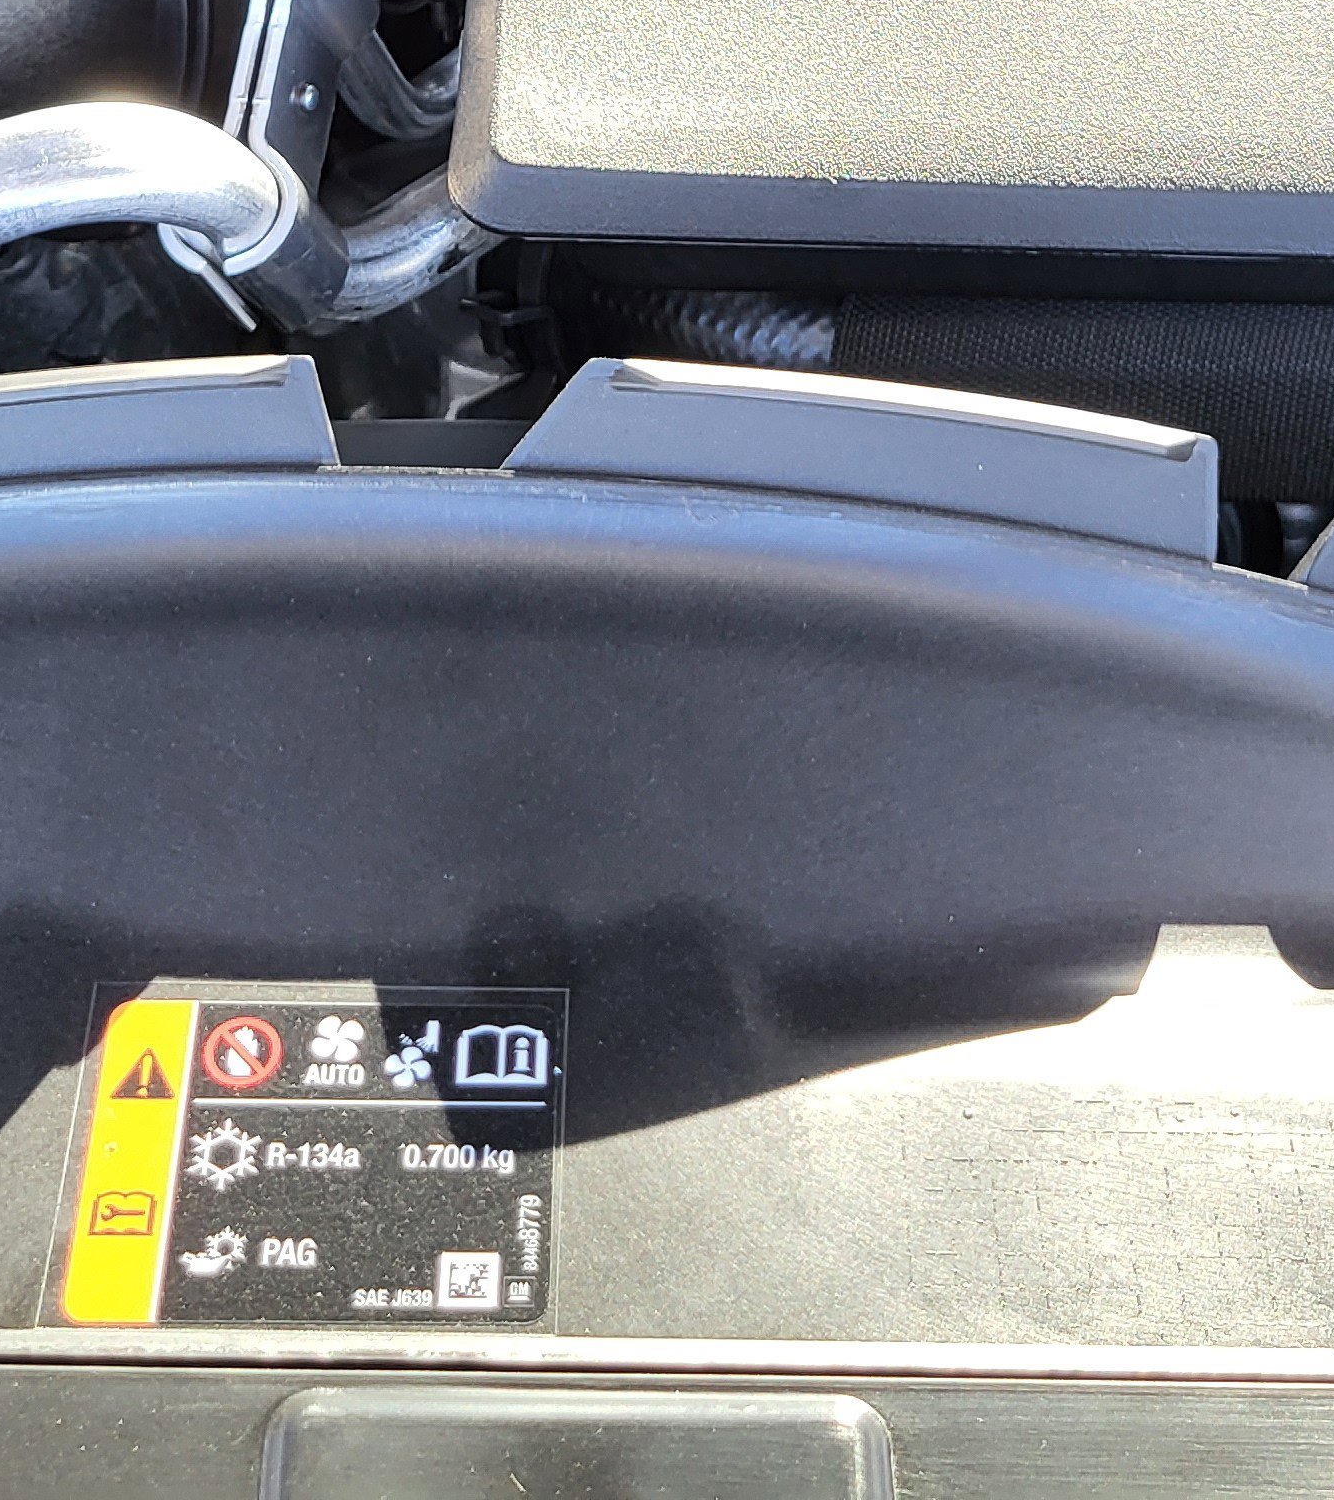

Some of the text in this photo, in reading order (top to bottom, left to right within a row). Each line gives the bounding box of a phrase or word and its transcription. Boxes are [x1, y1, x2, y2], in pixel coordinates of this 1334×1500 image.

[303, 1062, 366, 1086] AUTO
[266, 1142, 516, 1176] R-134a 0.700 kg
[260, 1237, 318, 1268] PAG
[353, 1289, 433, 1309] SAE J639
[509, 1279, 530, 1296] GM
